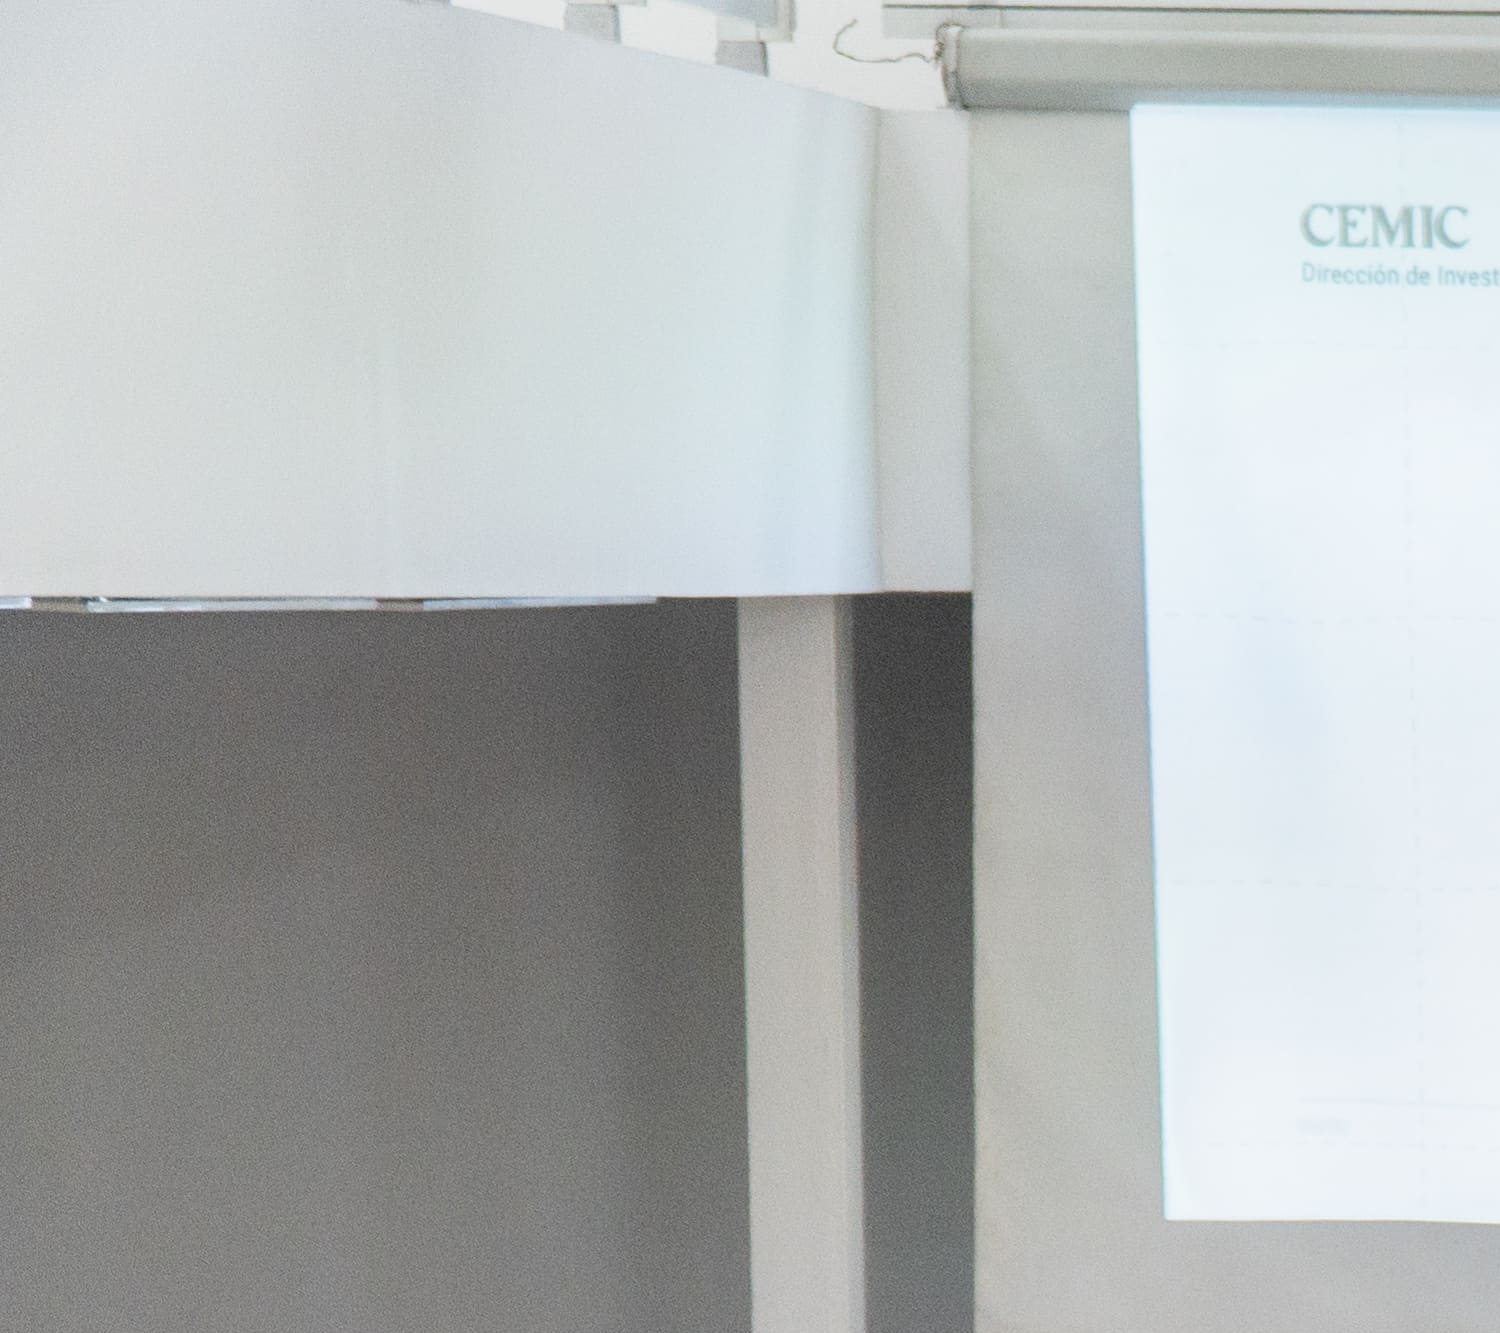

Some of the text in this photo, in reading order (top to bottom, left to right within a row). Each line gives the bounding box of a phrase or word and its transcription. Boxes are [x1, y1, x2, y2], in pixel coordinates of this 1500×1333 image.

[1300, 203, 1470, 250] CEMIC
[1302, 261, 1399, 286] Dirección
[1405, 265, 1431, 286] de
